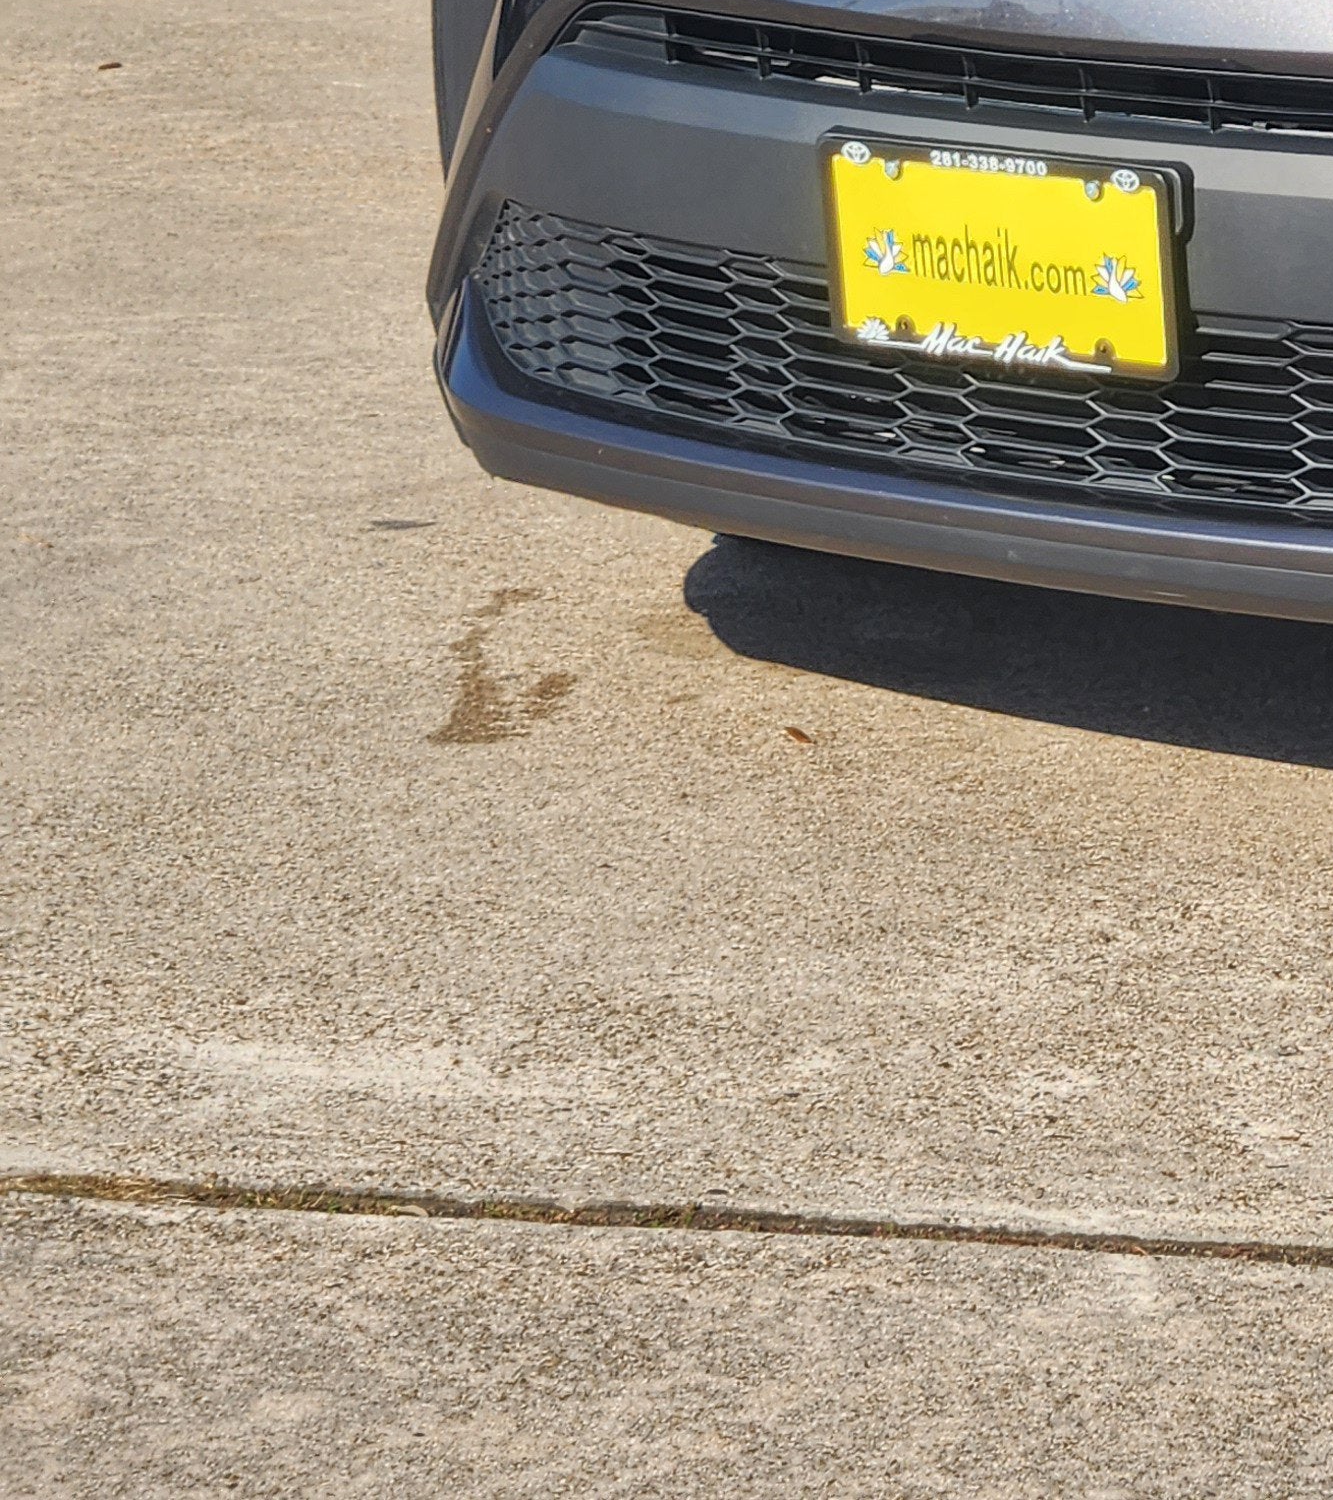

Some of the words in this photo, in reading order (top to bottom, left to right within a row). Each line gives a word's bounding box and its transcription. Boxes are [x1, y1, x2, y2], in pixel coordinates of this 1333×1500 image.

[930, 149, 1048, 176] 281-338-9700
[911, 224, 1088, 296] machaik.com
[920, 321, 990, 356] Mac
[994, 331, 1075, 367] Haik
